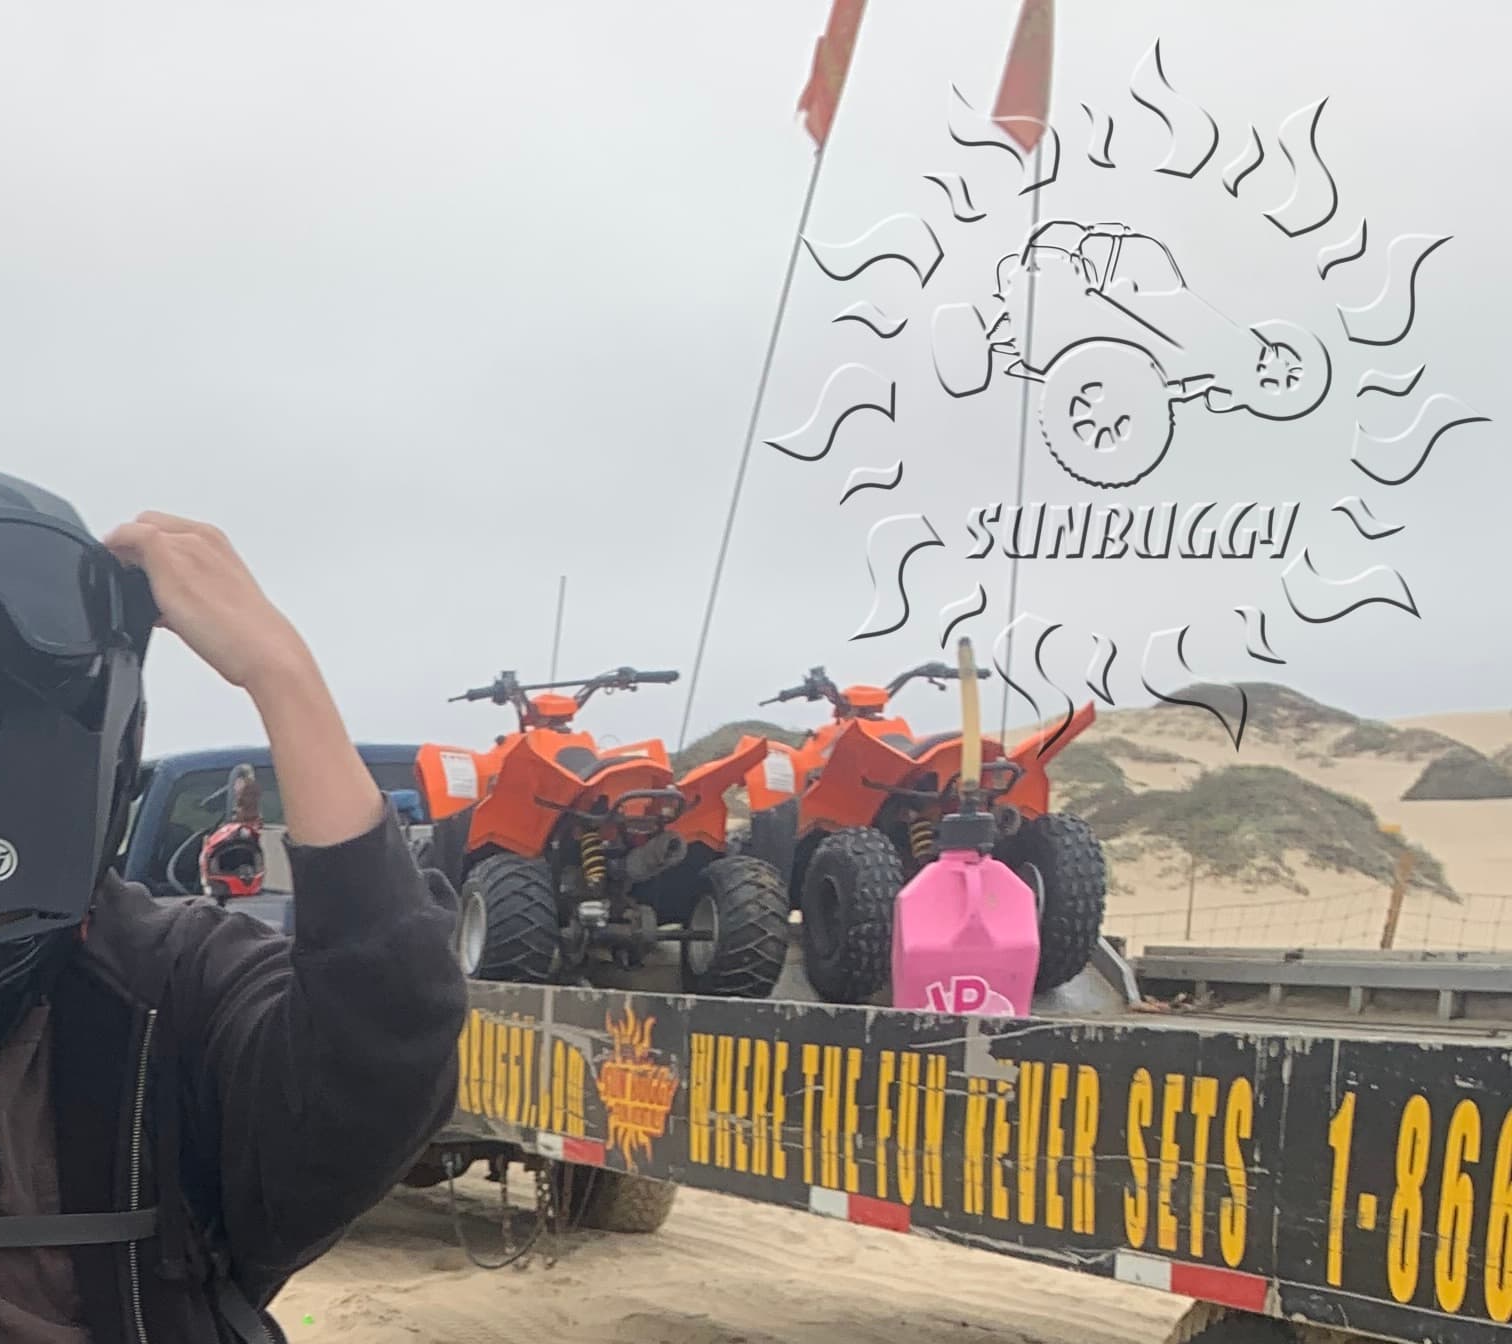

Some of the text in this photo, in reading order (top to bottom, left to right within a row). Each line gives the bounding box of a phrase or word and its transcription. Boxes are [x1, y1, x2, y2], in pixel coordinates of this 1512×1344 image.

[690, 1032, 789, 1179] WHERE
[802, 1043, 862, 1193] THE
[876, 1050, 947, 1208] FUN
[964, 1060, 1100, 1235] NEVER
[1124, 1066, 1254, 1268] SETS
